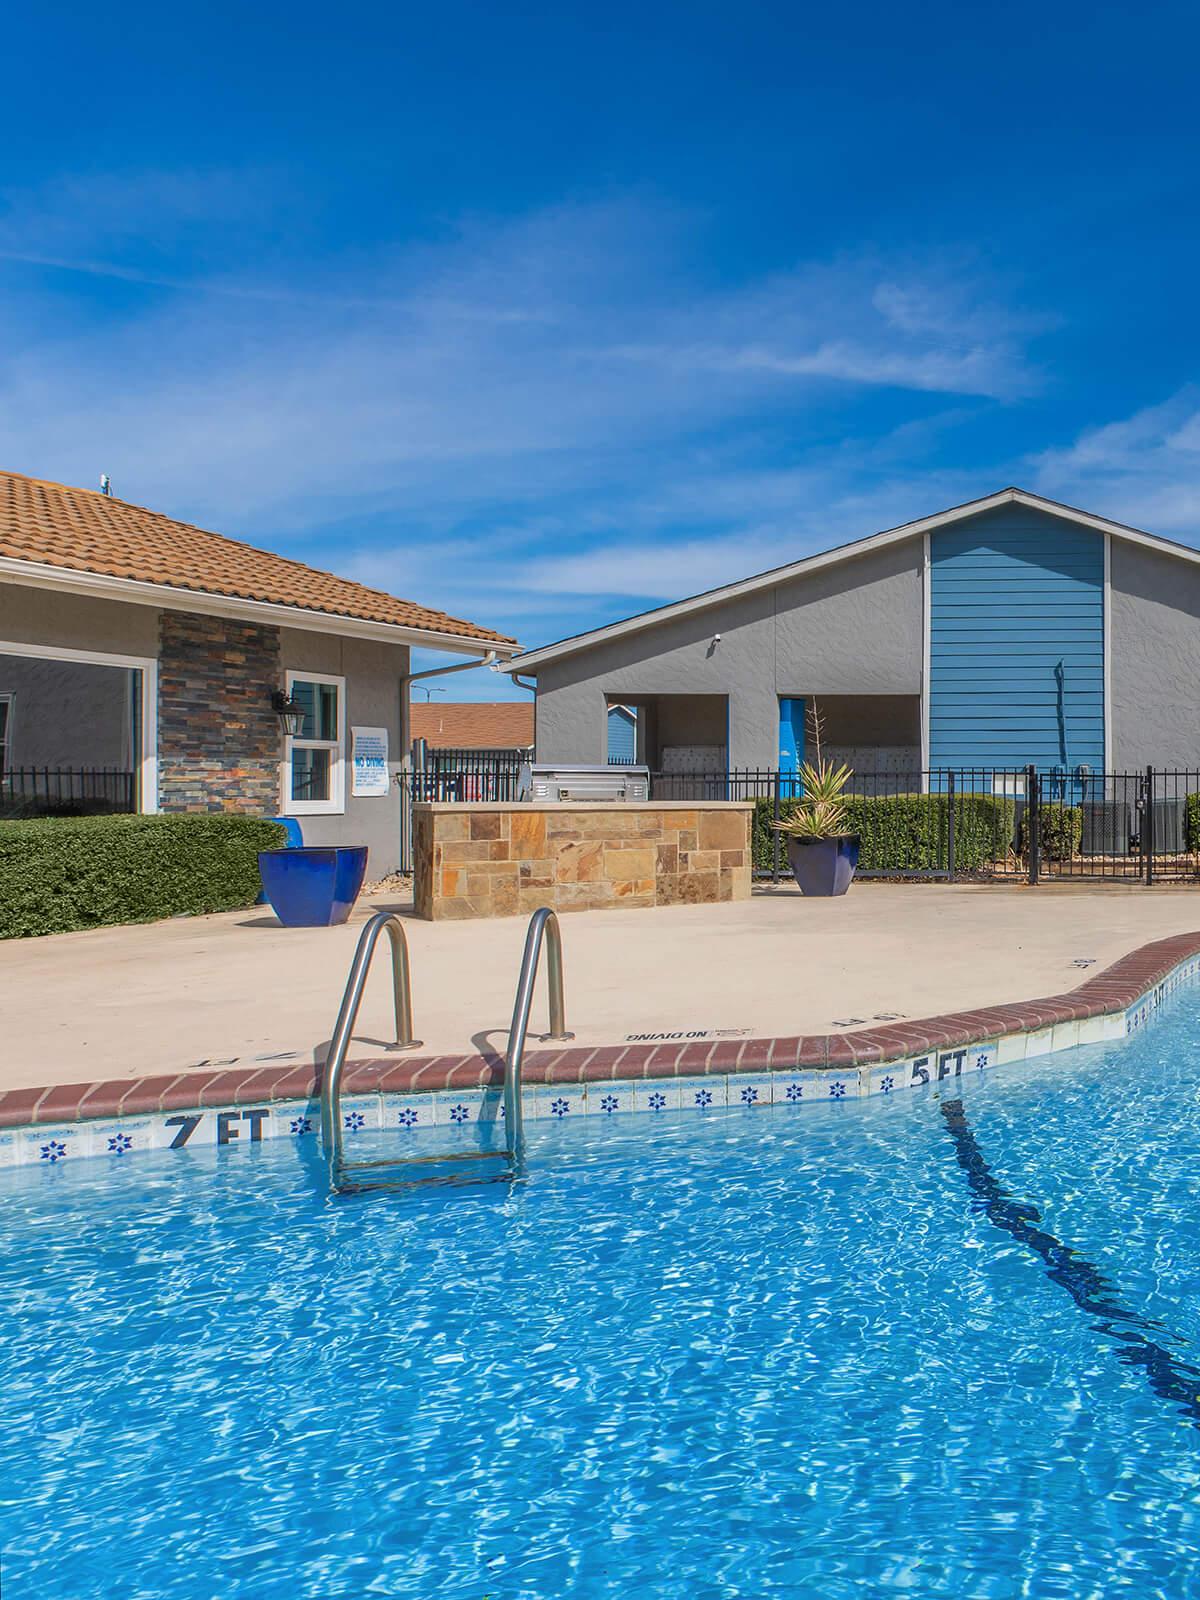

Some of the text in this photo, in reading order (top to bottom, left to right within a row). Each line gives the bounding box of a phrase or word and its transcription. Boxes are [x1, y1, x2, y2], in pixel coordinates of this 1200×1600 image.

[355, 756, 385, 768] NO DIVING
[625, 1031, 708, 1041] NO DIVING
[910, 1049, 967, 1088] 5 FT
[165, 1109, 270, 1149] 7 FT
